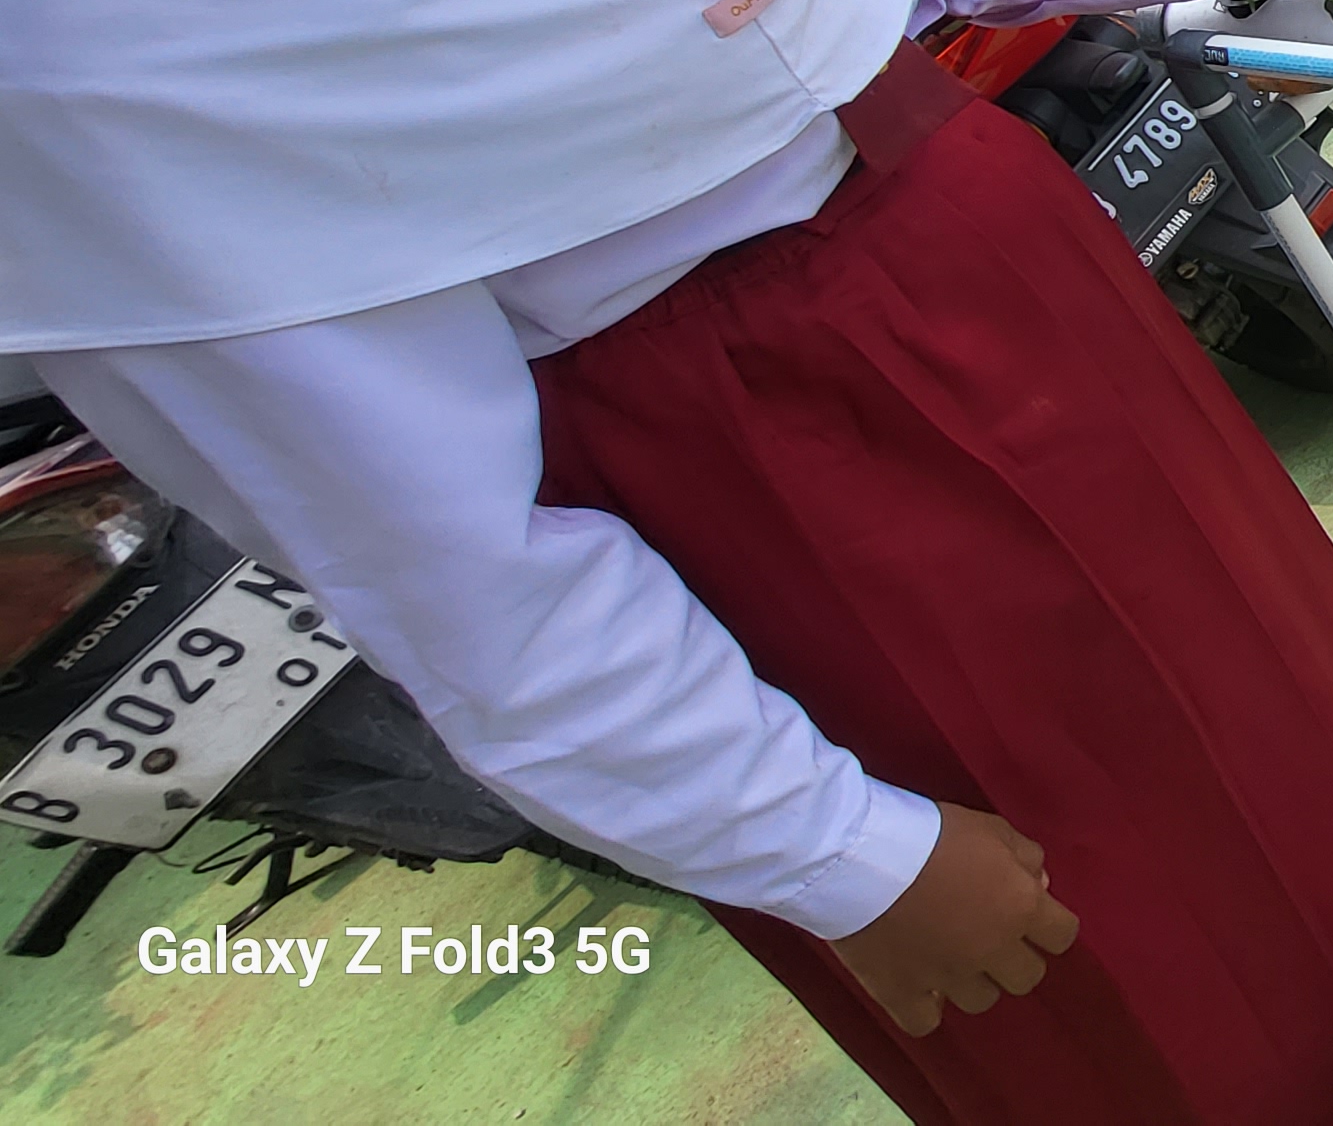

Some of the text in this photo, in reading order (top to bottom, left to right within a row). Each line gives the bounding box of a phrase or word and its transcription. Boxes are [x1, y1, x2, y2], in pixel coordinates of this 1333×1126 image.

[1203, 49, 1226, 62] RUC
[1113, 100, 1198, 189] 4789
[1144, 208, 1193, 255] YAMAHA
[53, 583, 161, 671] HONDA
[0, 790, 80, 823] B
[63, 627, 245, 770] 3029
